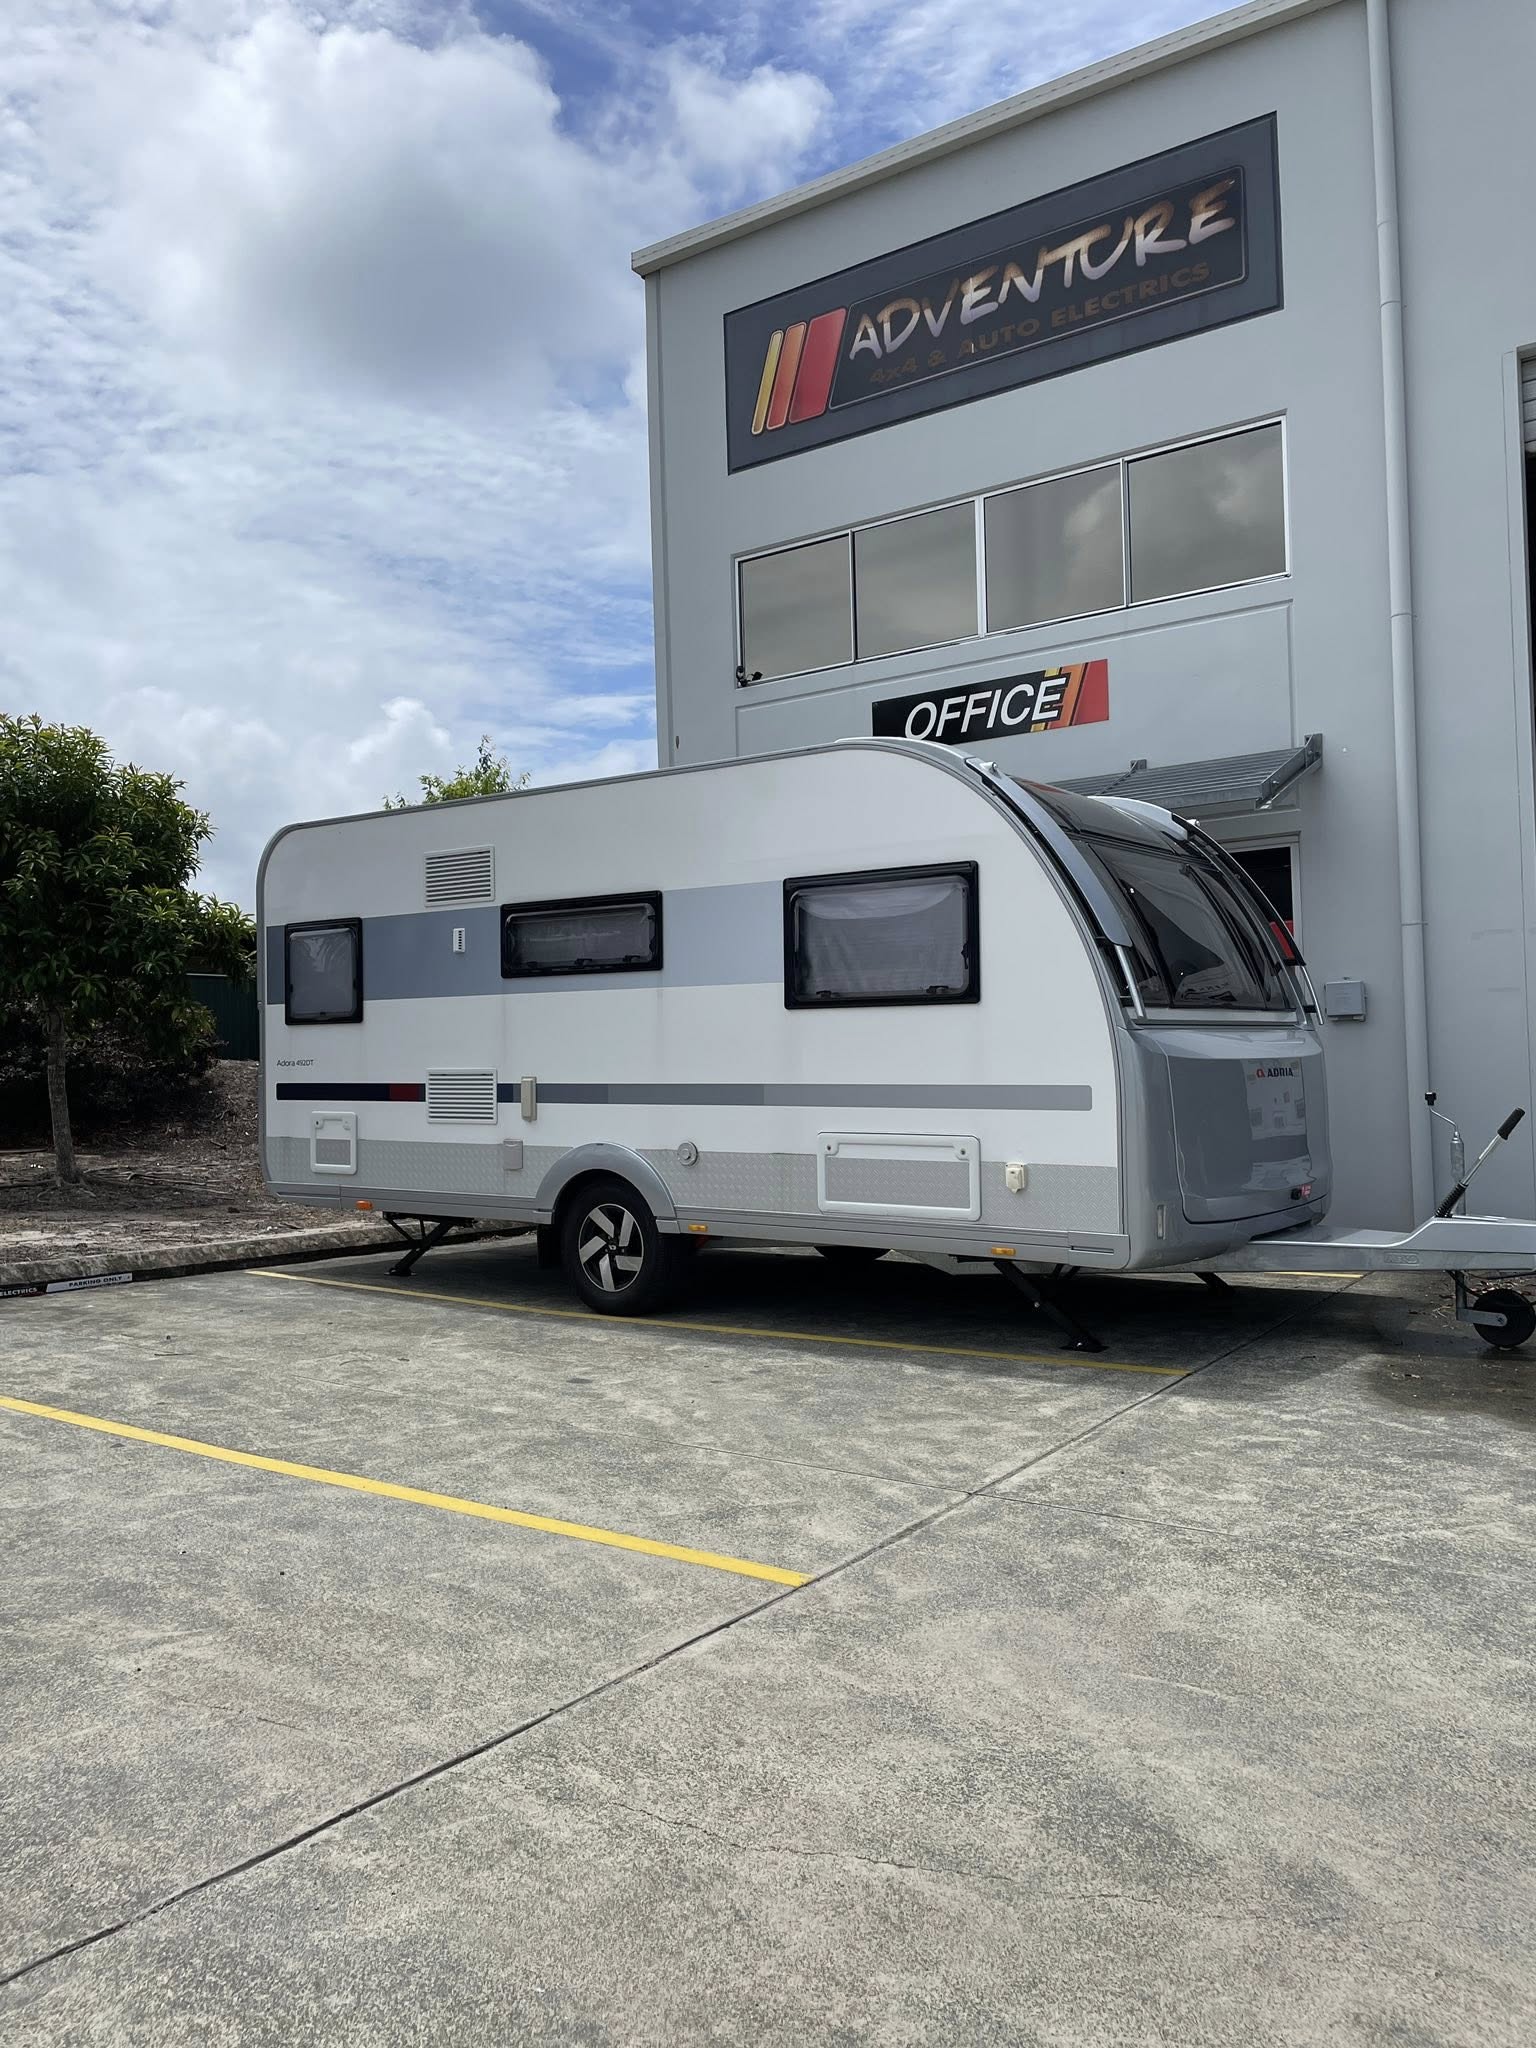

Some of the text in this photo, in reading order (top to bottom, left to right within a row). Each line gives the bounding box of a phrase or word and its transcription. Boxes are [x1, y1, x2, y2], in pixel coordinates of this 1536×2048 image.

[849, 178, 1235, 360] ADVENTURE
[870, 261, 1211, 384] 4x4 & AUTO ELECTRICS
[904, 677, 1066, 740] OFFICE
[276, 1059, 296, 1067] Adora
[1267, 1067, 1294, 1077] ADRIA
[68, 1276, 122, 1288] PARKING ONLY
